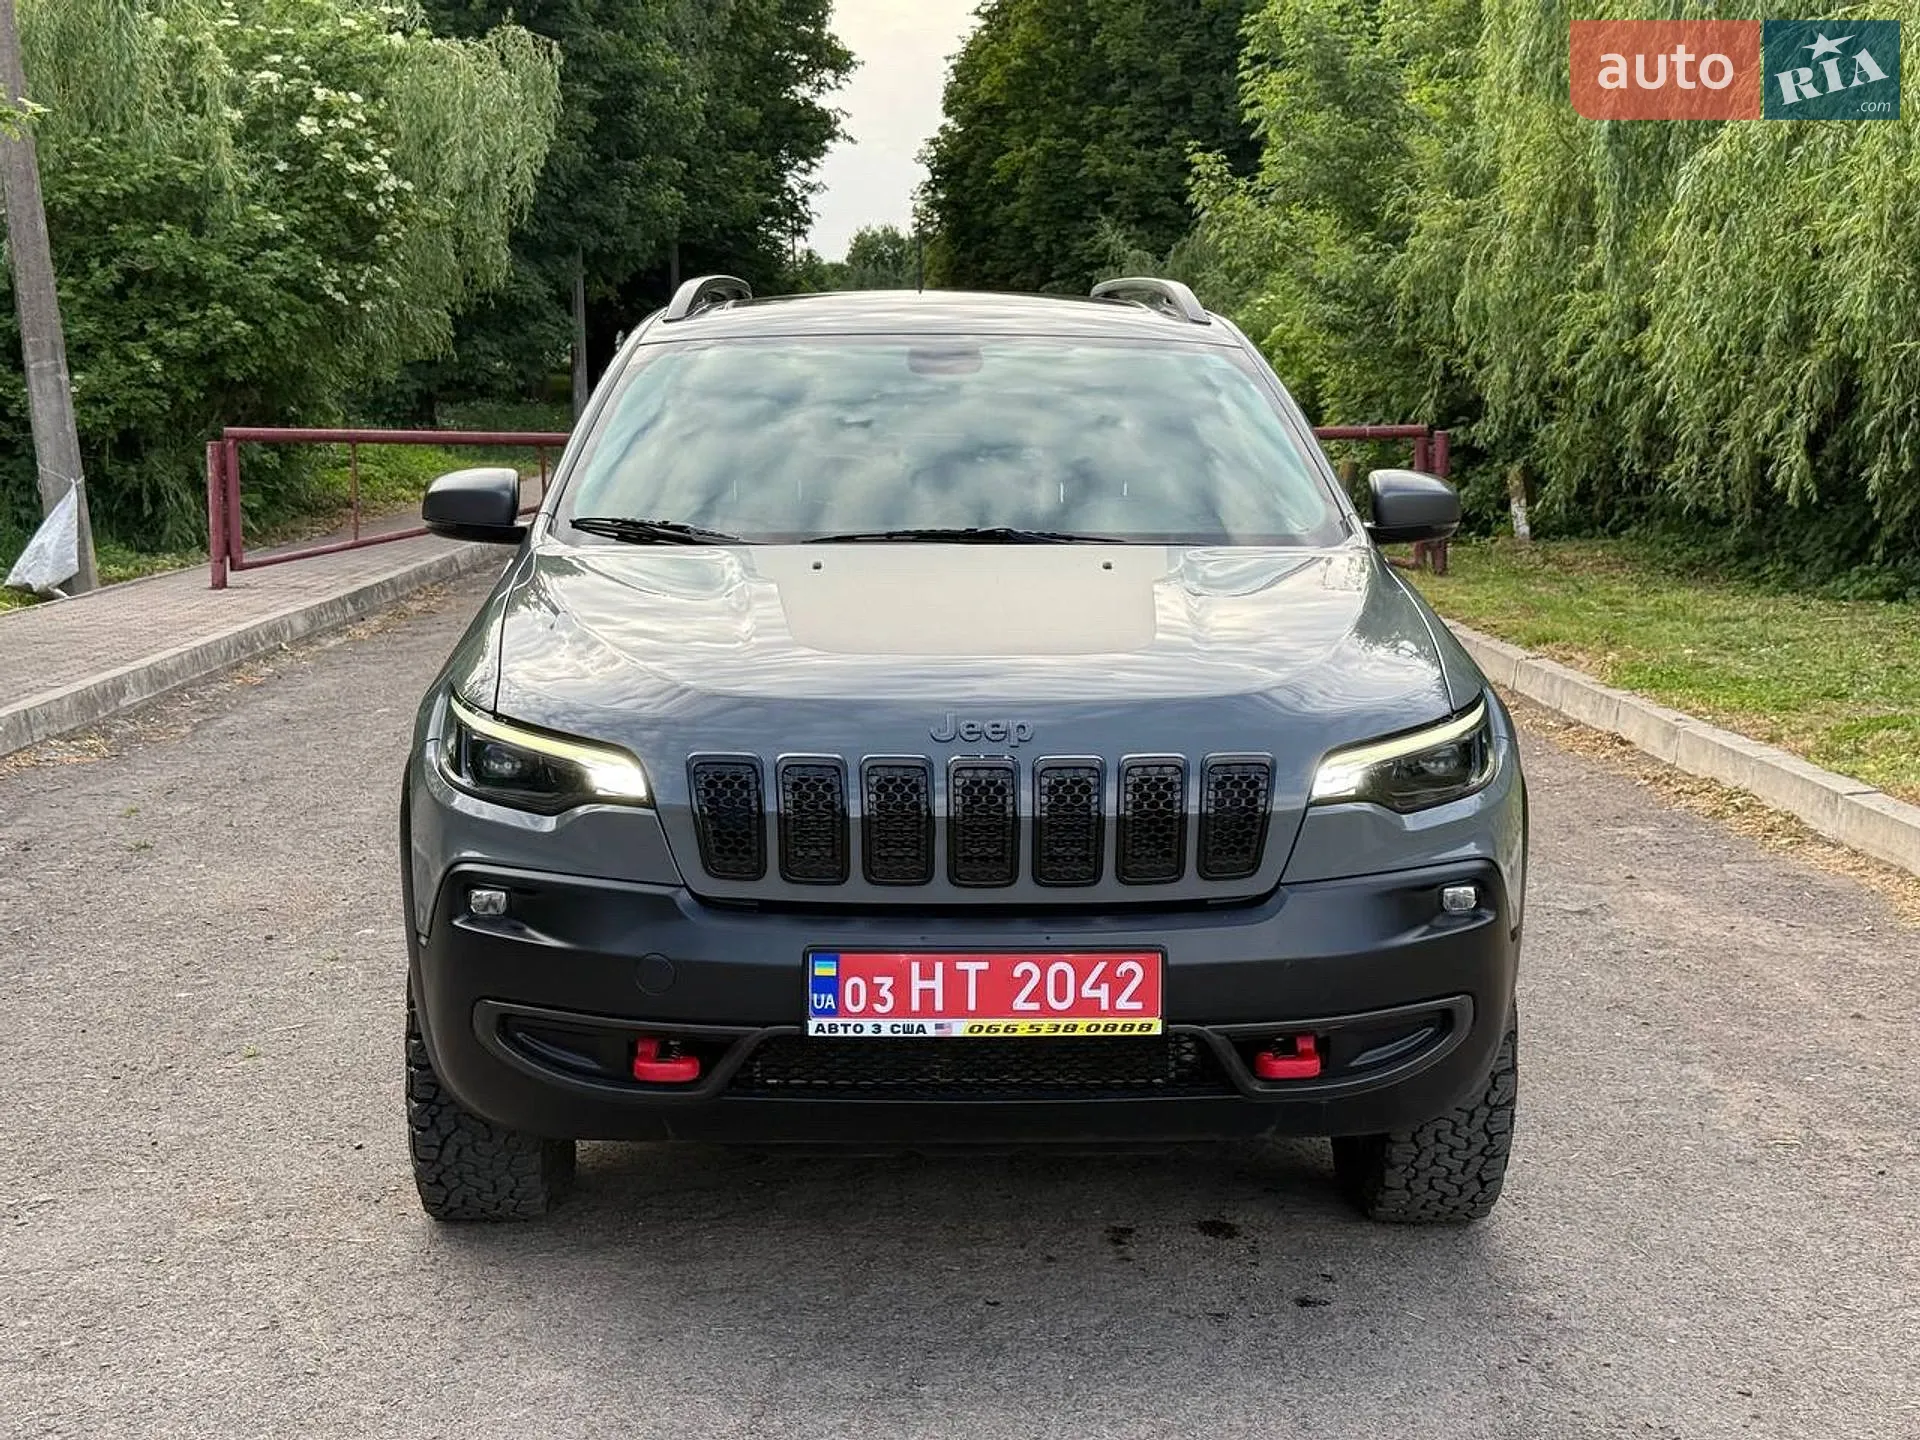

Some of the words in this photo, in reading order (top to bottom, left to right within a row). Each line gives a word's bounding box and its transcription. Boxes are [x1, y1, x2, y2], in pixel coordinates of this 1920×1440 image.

[929, 711, 1034, 748] Jeep
[844, 976, 895, 1014] 03
[910, 961, 989, 1011] HT
[1012, 960, 1145, 1011] 2042
[813, 993, 836, 1010] UA
[814, 1023, 864, 1034] АВТО
[890, 1023, 927, 1034] США
